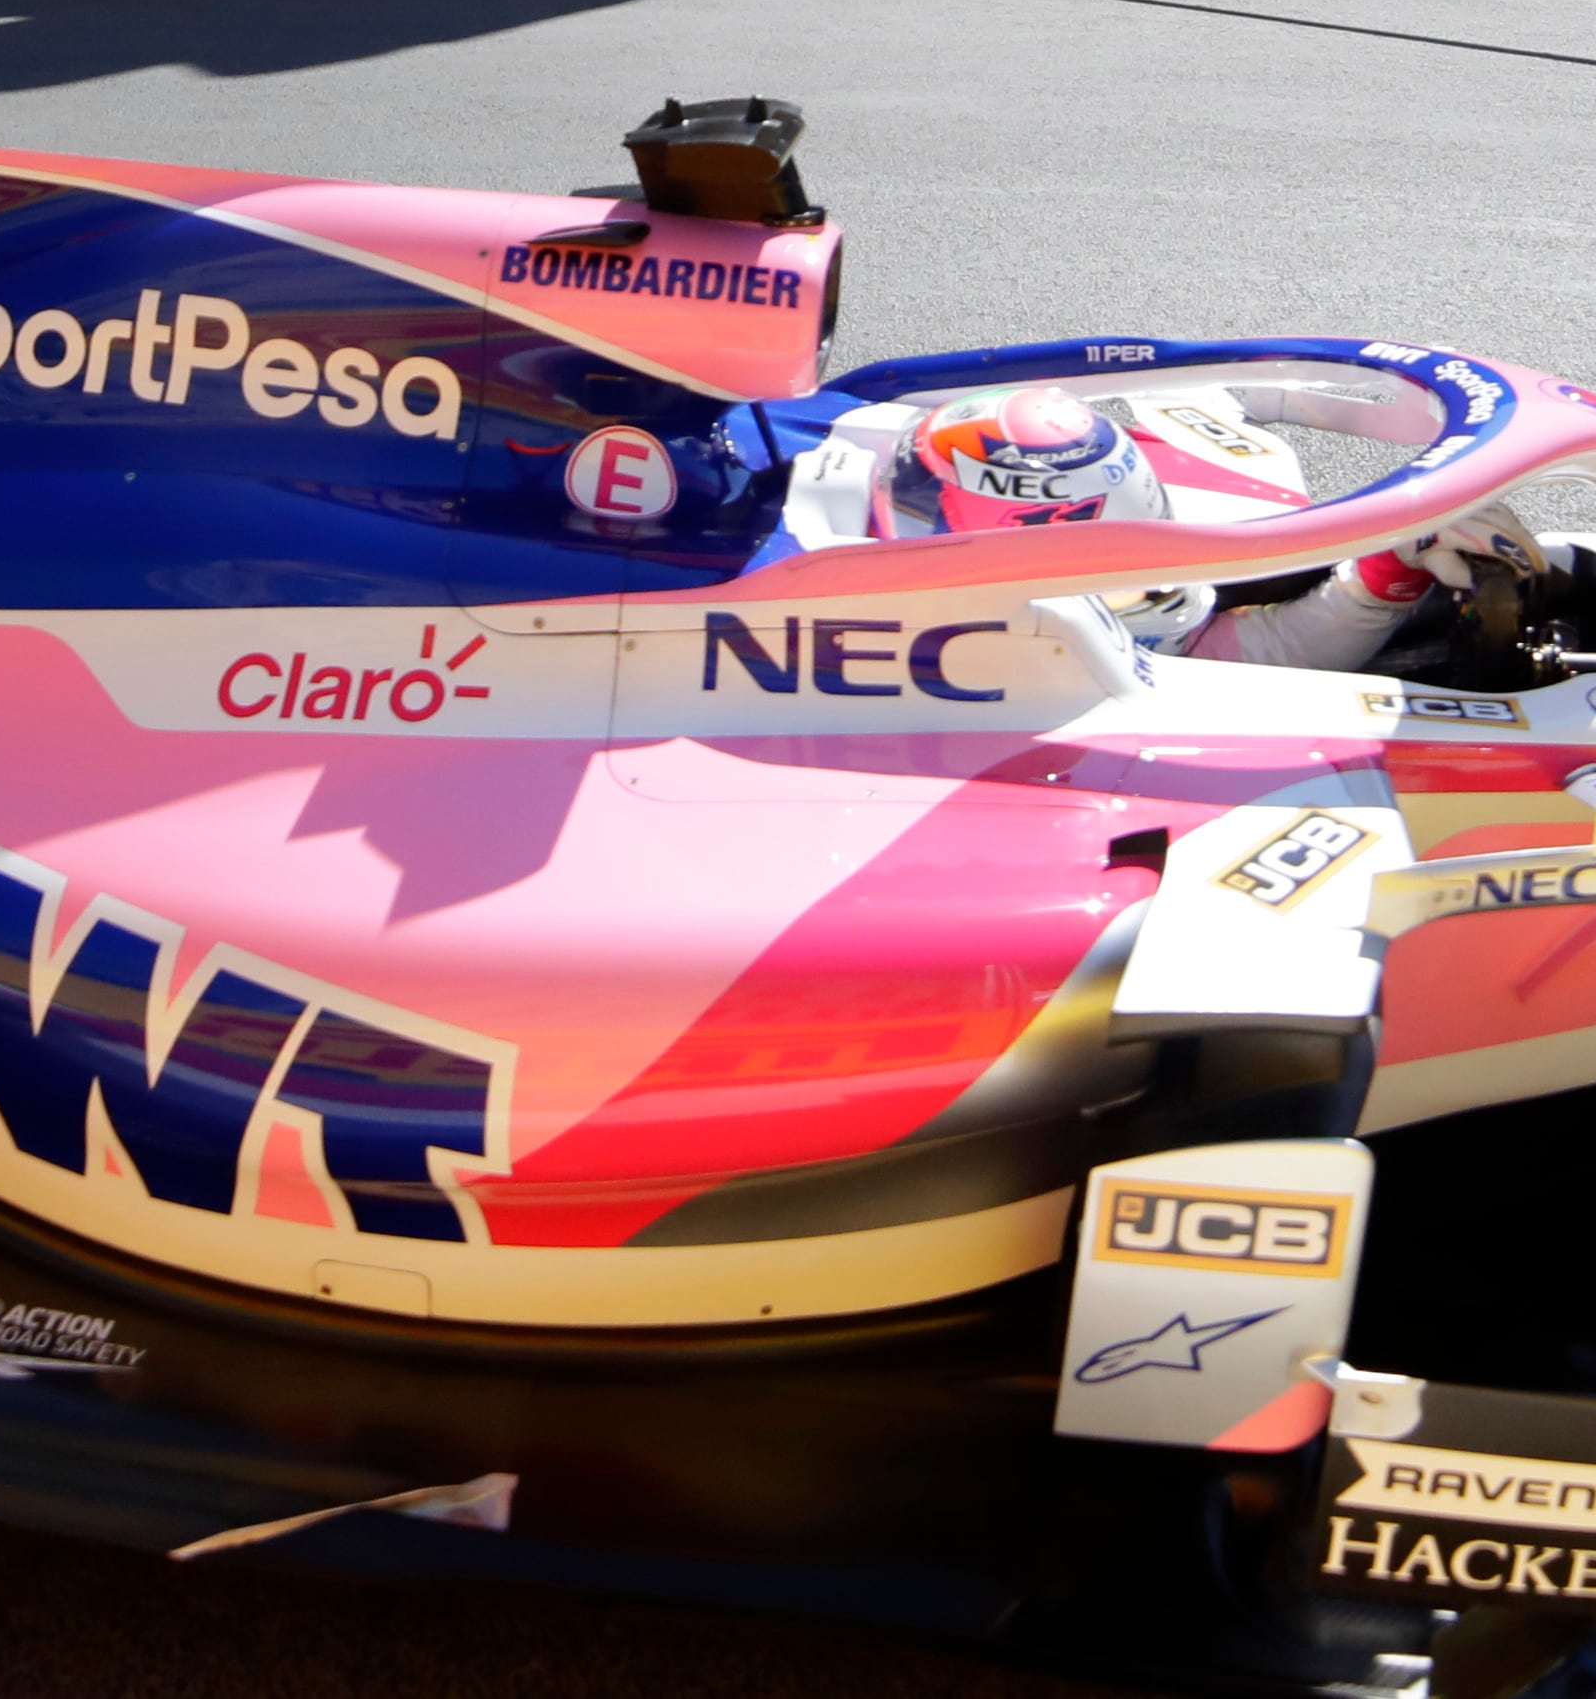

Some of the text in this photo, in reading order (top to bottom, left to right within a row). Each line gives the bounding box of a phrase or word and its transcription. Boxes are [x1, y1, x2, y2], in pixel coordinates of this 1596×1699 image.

[500, 245, 802, 309] BOMBARDIER
[1085, 344, 1156, 362] 11 PER
[594, 438, 650, 514] E
[977, 469, 1072, 500] NEC
[217, 628, 479, 723] Claro
[702, 611, 1008, 702] NEC
[1370, 696, 1518, 722] JCB
[1239, 814, 1361, 904] JCB
[1113, 1198, 1330, 1263] JCB
[1, 1303, 116, 1341] ACTION
[53, 1334, 147, 1366] SAFETY
